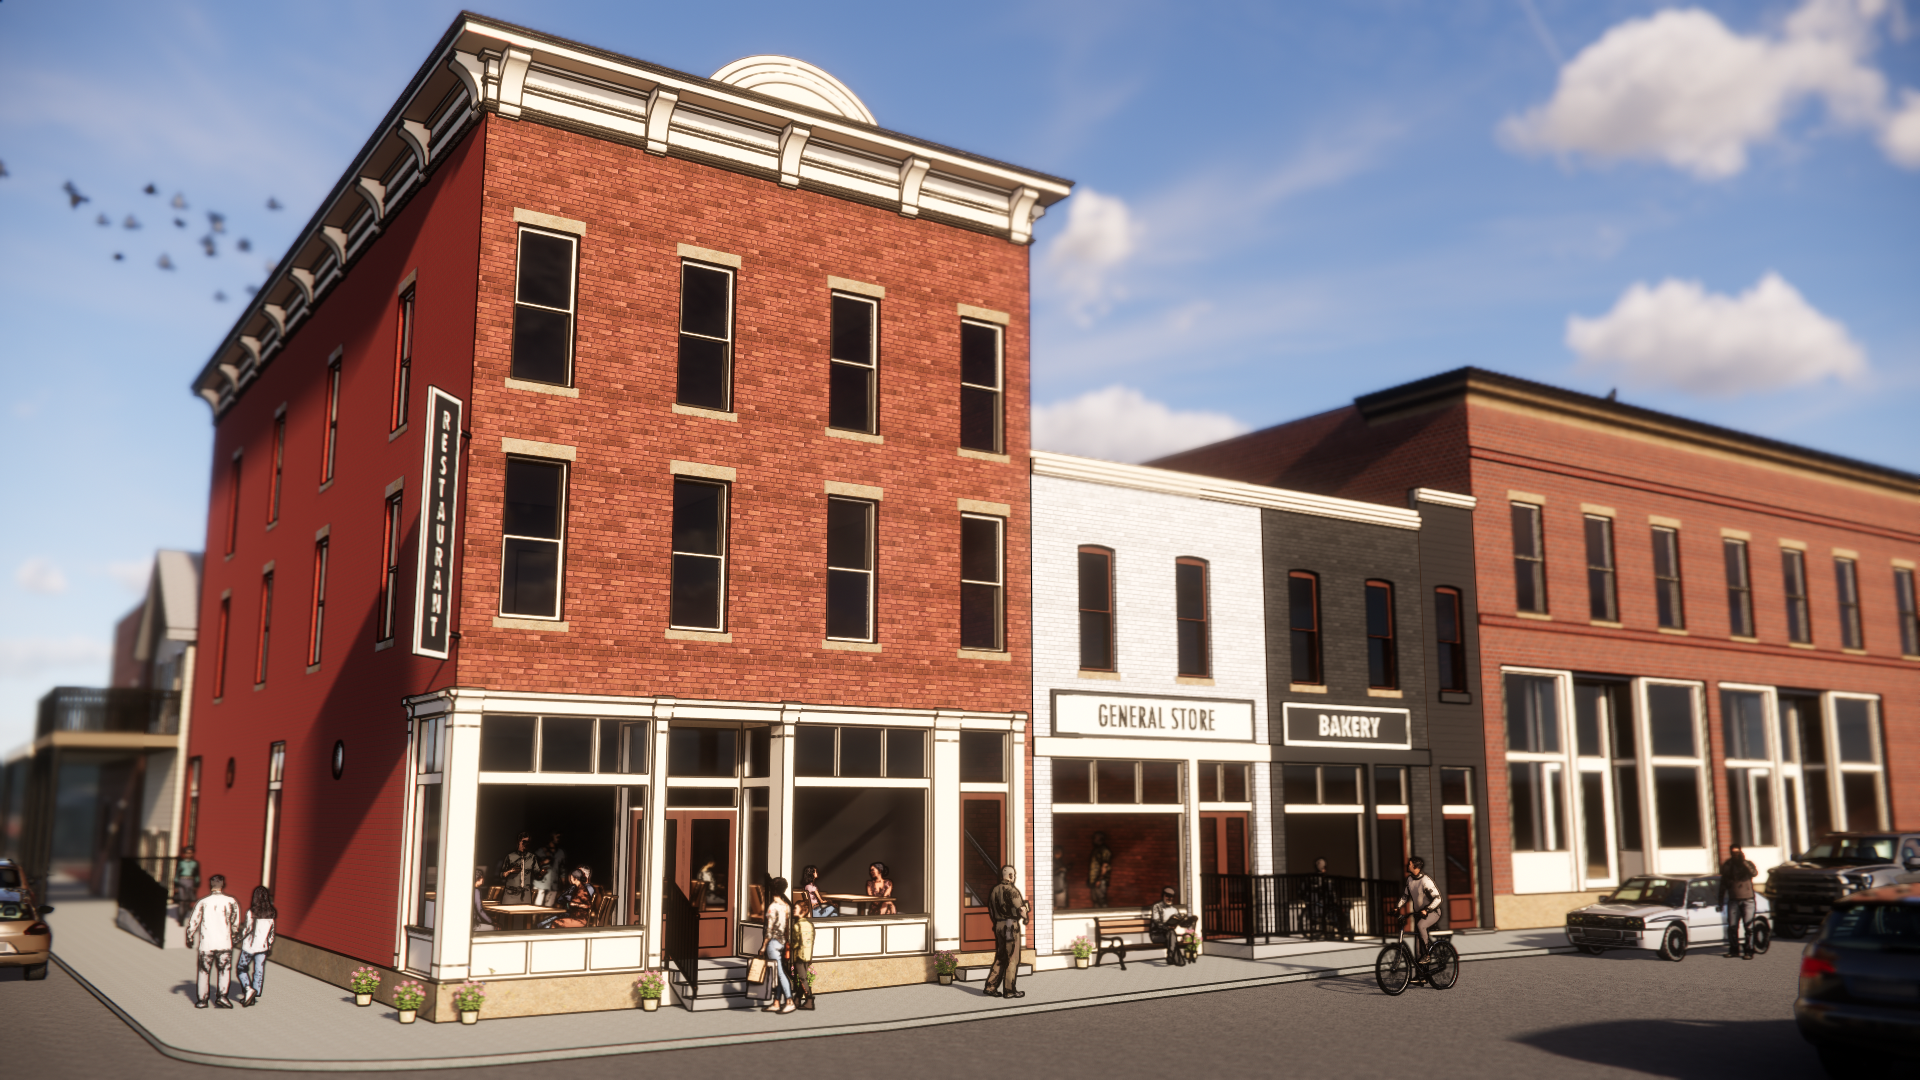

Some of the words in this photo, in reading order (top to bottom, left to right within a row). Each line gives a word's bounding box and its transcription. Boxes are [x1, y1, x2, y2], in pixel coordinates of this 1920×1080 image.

[430, 410, 451, 637] RESTAURANT
[1098, 704, 1166, 730] GENERAL
[1171, 708, 1216, 731] STORE
[1318, 714, 1381, 738] BAKERY
